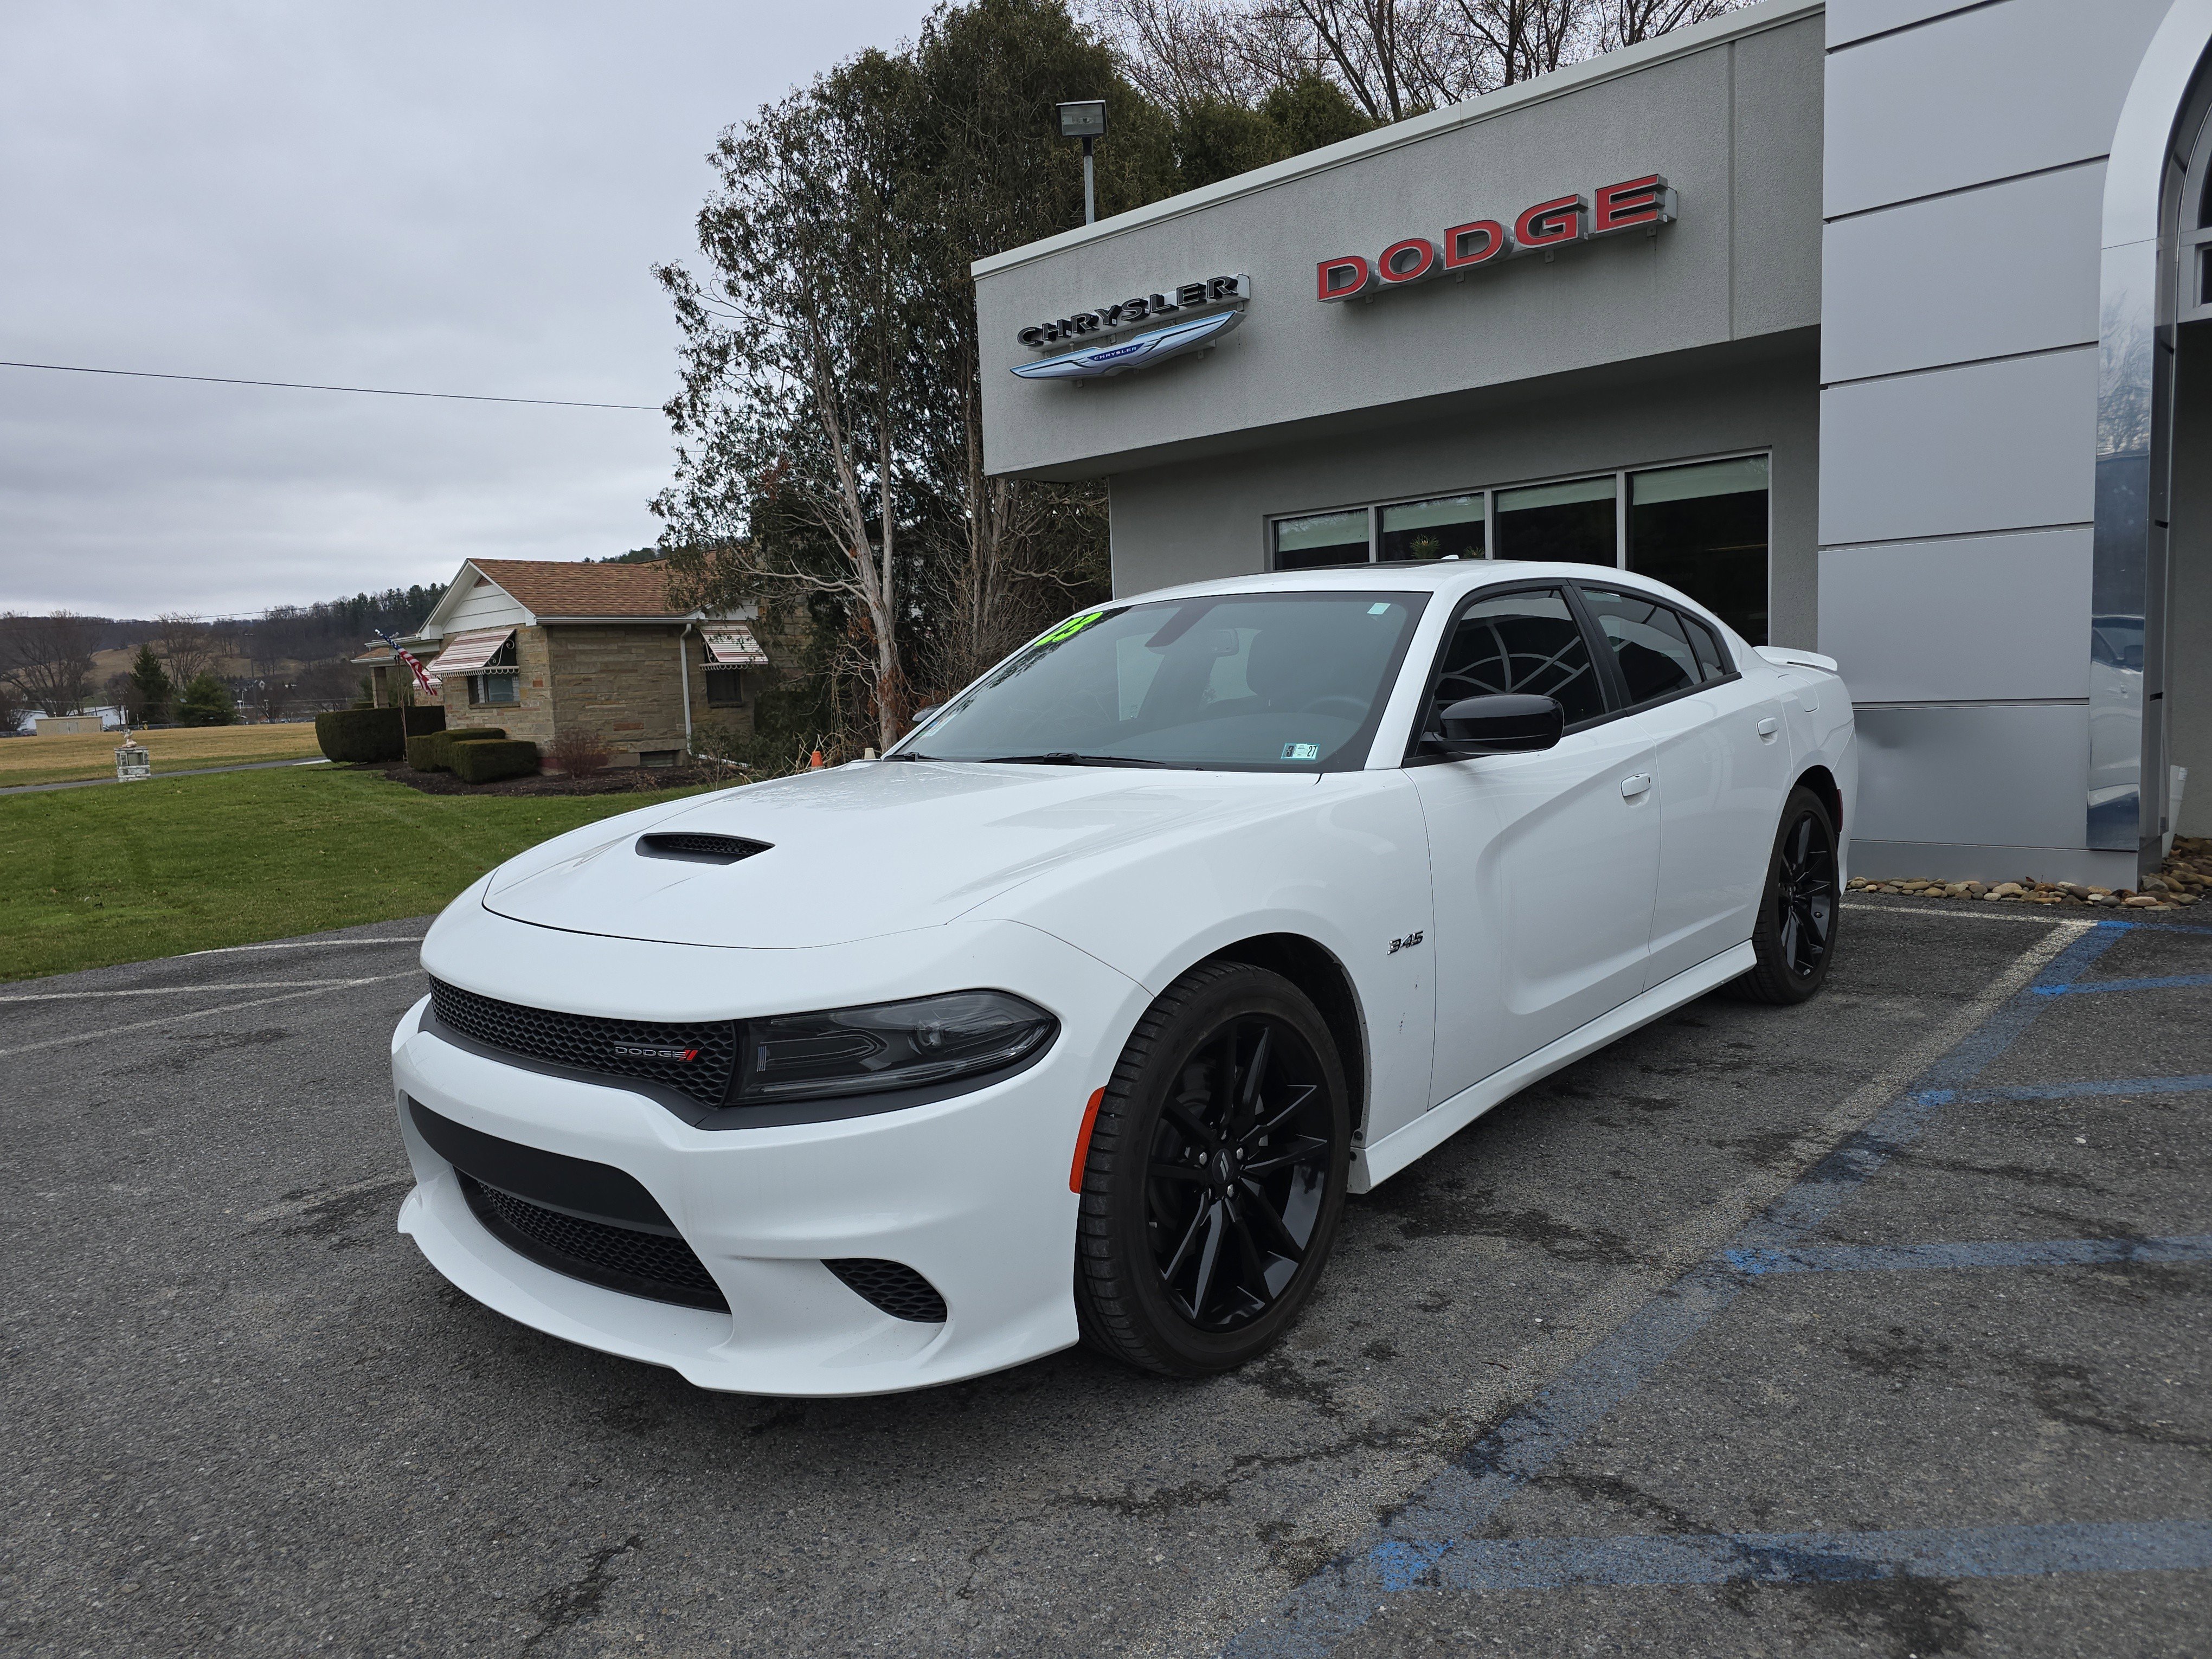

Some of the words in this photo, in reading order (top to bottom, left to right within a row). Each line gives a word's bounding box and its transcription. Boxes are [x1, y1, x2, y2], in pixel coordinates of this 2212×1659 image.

[1316, 174, 1668, 303] DODGE
[1017, 275, 1238, 346] CHRYSLER
[1094, 346, 1137, 361] CHRYSLER
[1034, 611, 1104, 647] 23
[1285, 745, 1295, 757] 3
[1307, 745, 1317, 757] 27
[1387, 930, 1424, 955] 345
[615, 1046, 687, 1058] DODGE
